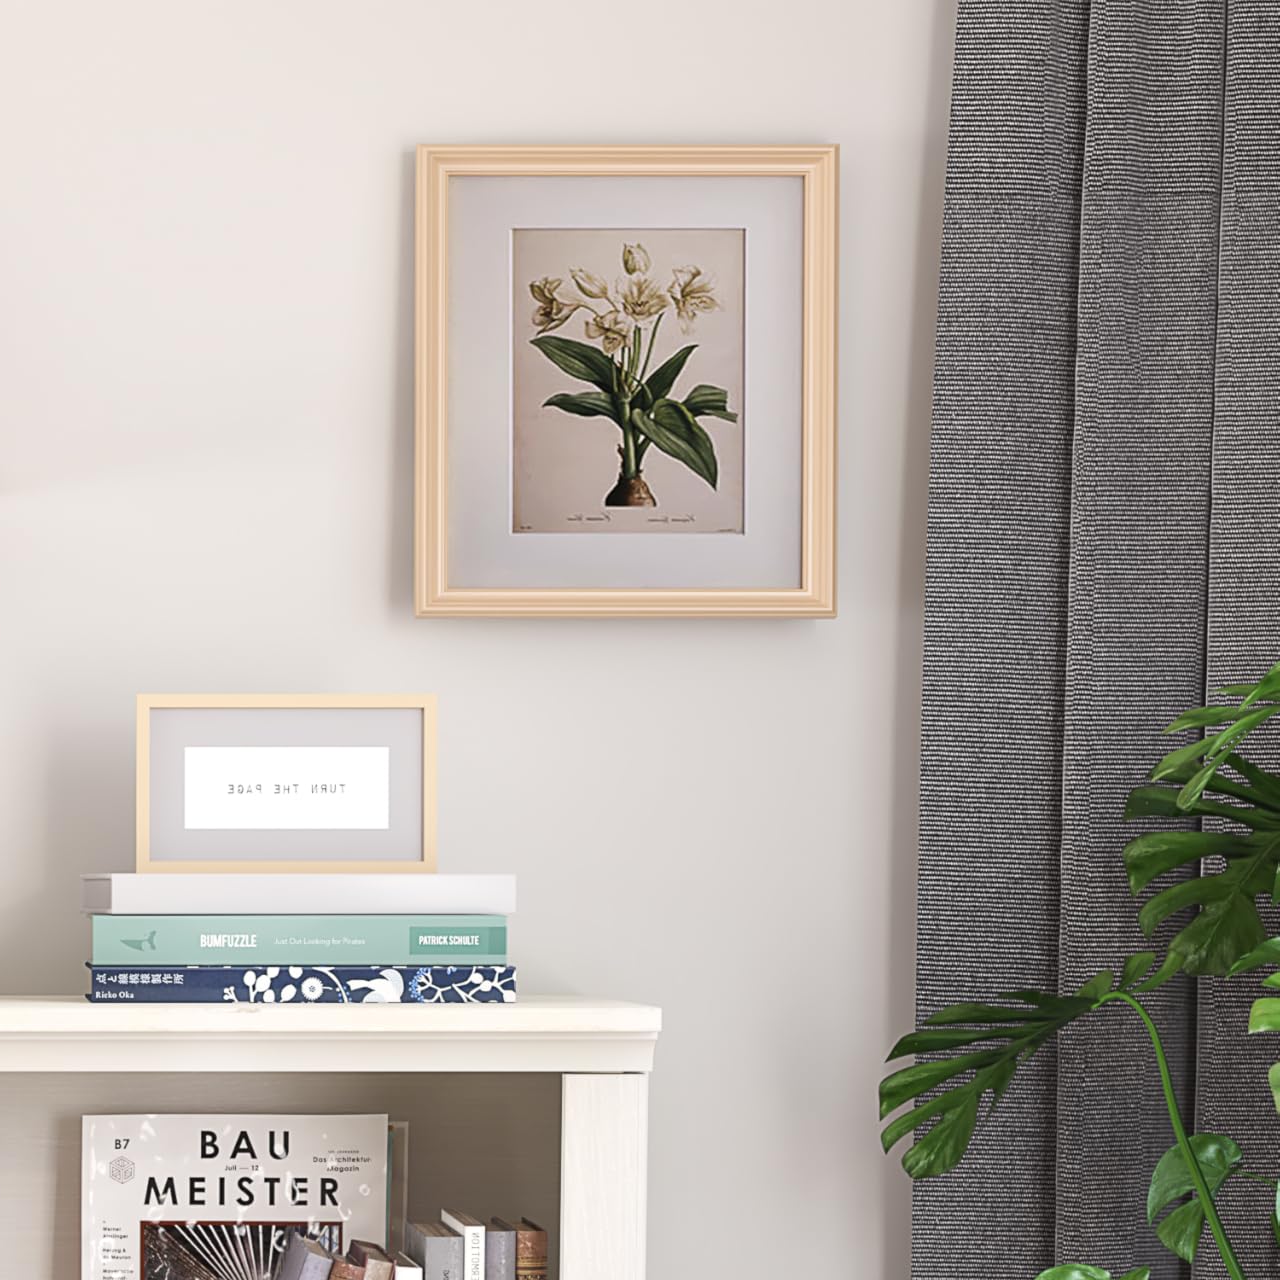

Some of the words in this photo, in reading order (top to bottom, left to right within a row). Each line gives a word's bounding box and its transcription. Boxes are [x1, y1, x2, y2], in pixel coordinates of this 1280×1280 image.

[200, 934, 257, 948] BUMFUZZLE
[418, 935, 448, 946] PATRICK
[449, 935, 480, 946] SCHULTE
[114, 1138, 130, 1150] B7
[200, 1130, 290, 1160] BAU
[250, 1164, 260, 1172] 12
[144, 1177, 339, 1206] MEISTER
